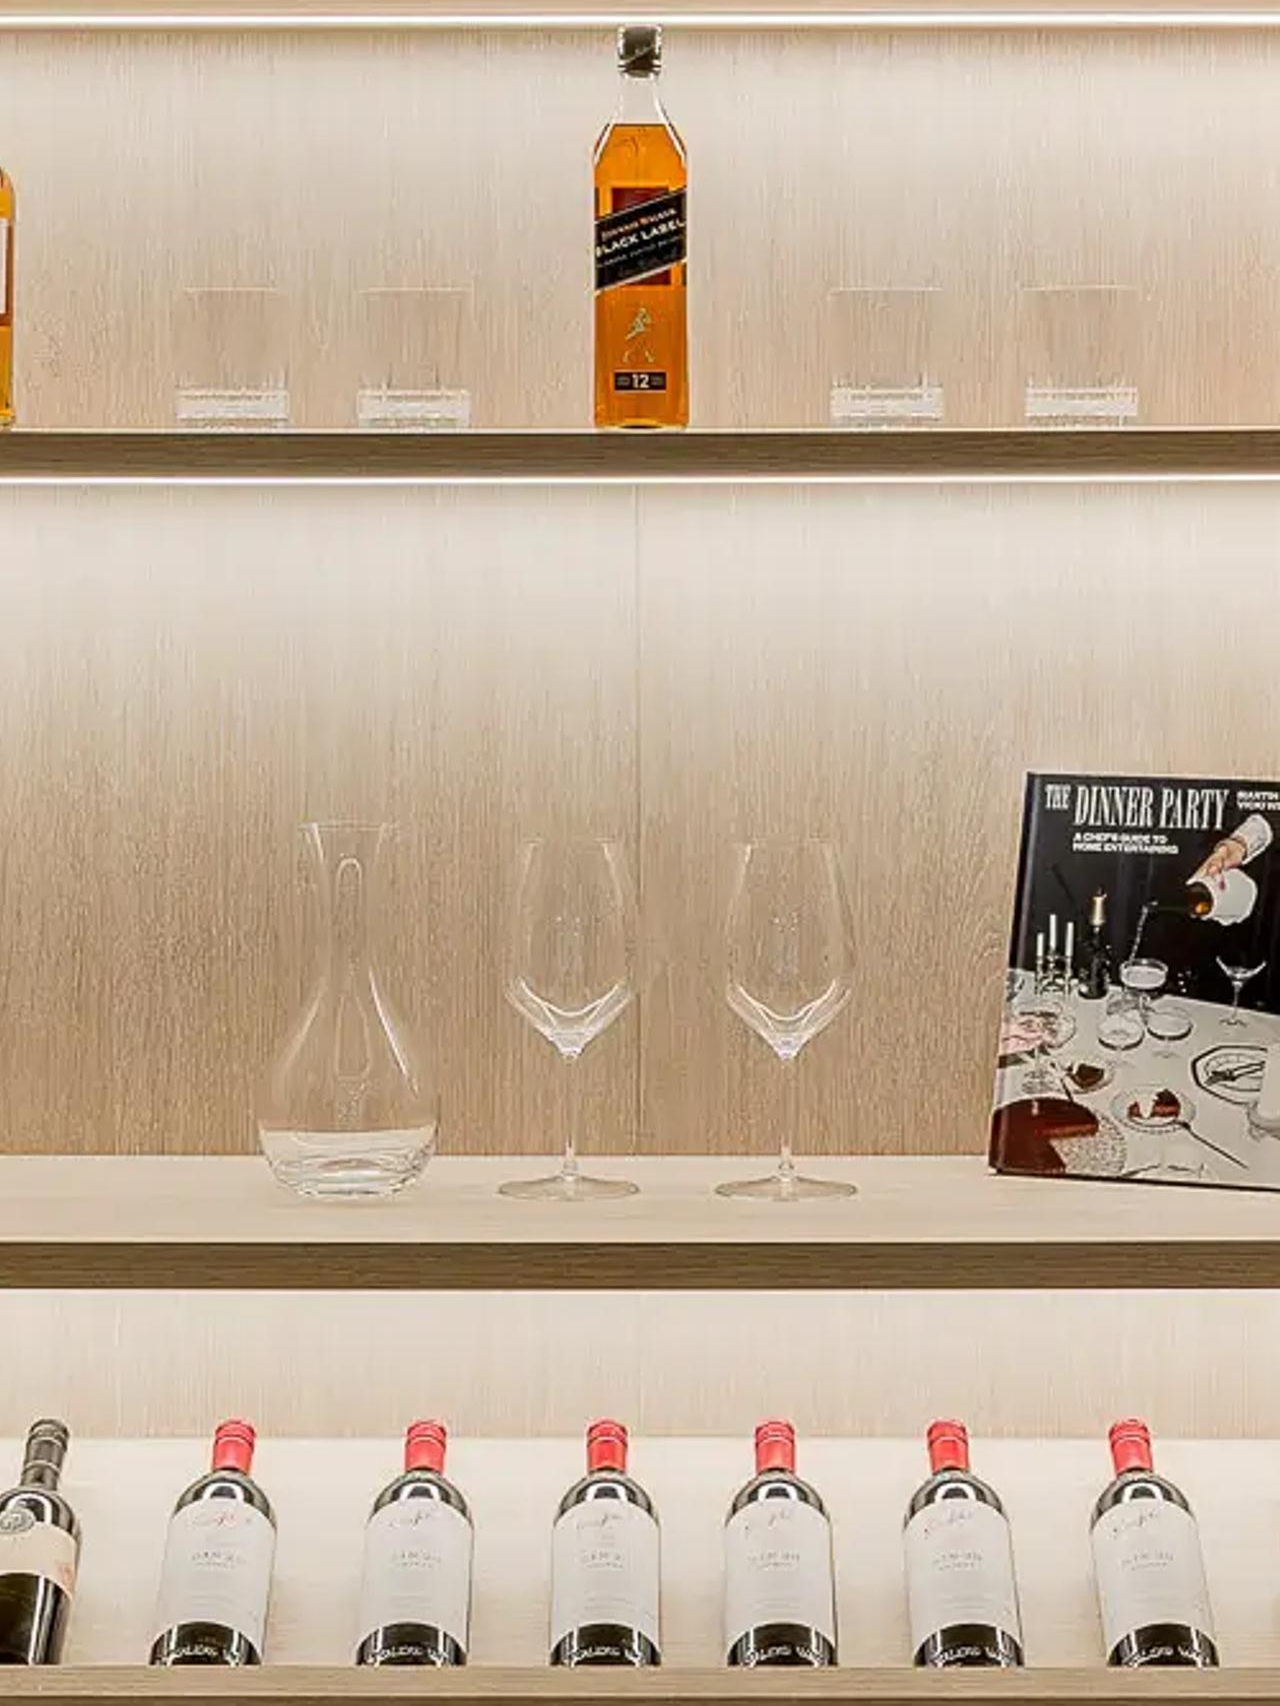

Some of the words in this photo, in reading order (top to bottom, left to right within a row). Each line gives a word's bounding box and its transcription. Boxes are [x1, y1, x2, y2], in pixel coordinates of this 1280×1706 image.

[595, 233, 640, 259] BLACK
[640, 218, 688, 241] LABEL
[631, 373, 650, 389] 12
[1045, 783, 1071, 811] THE
[1073, 785, 1154, 828] DINNER
[1160, 786, 1230, 831] PARTY
[1072, 832, 1081, 842] A
[1152, 834, 1169, 845] TO
[1072, 842, 1102, 852] HOME
